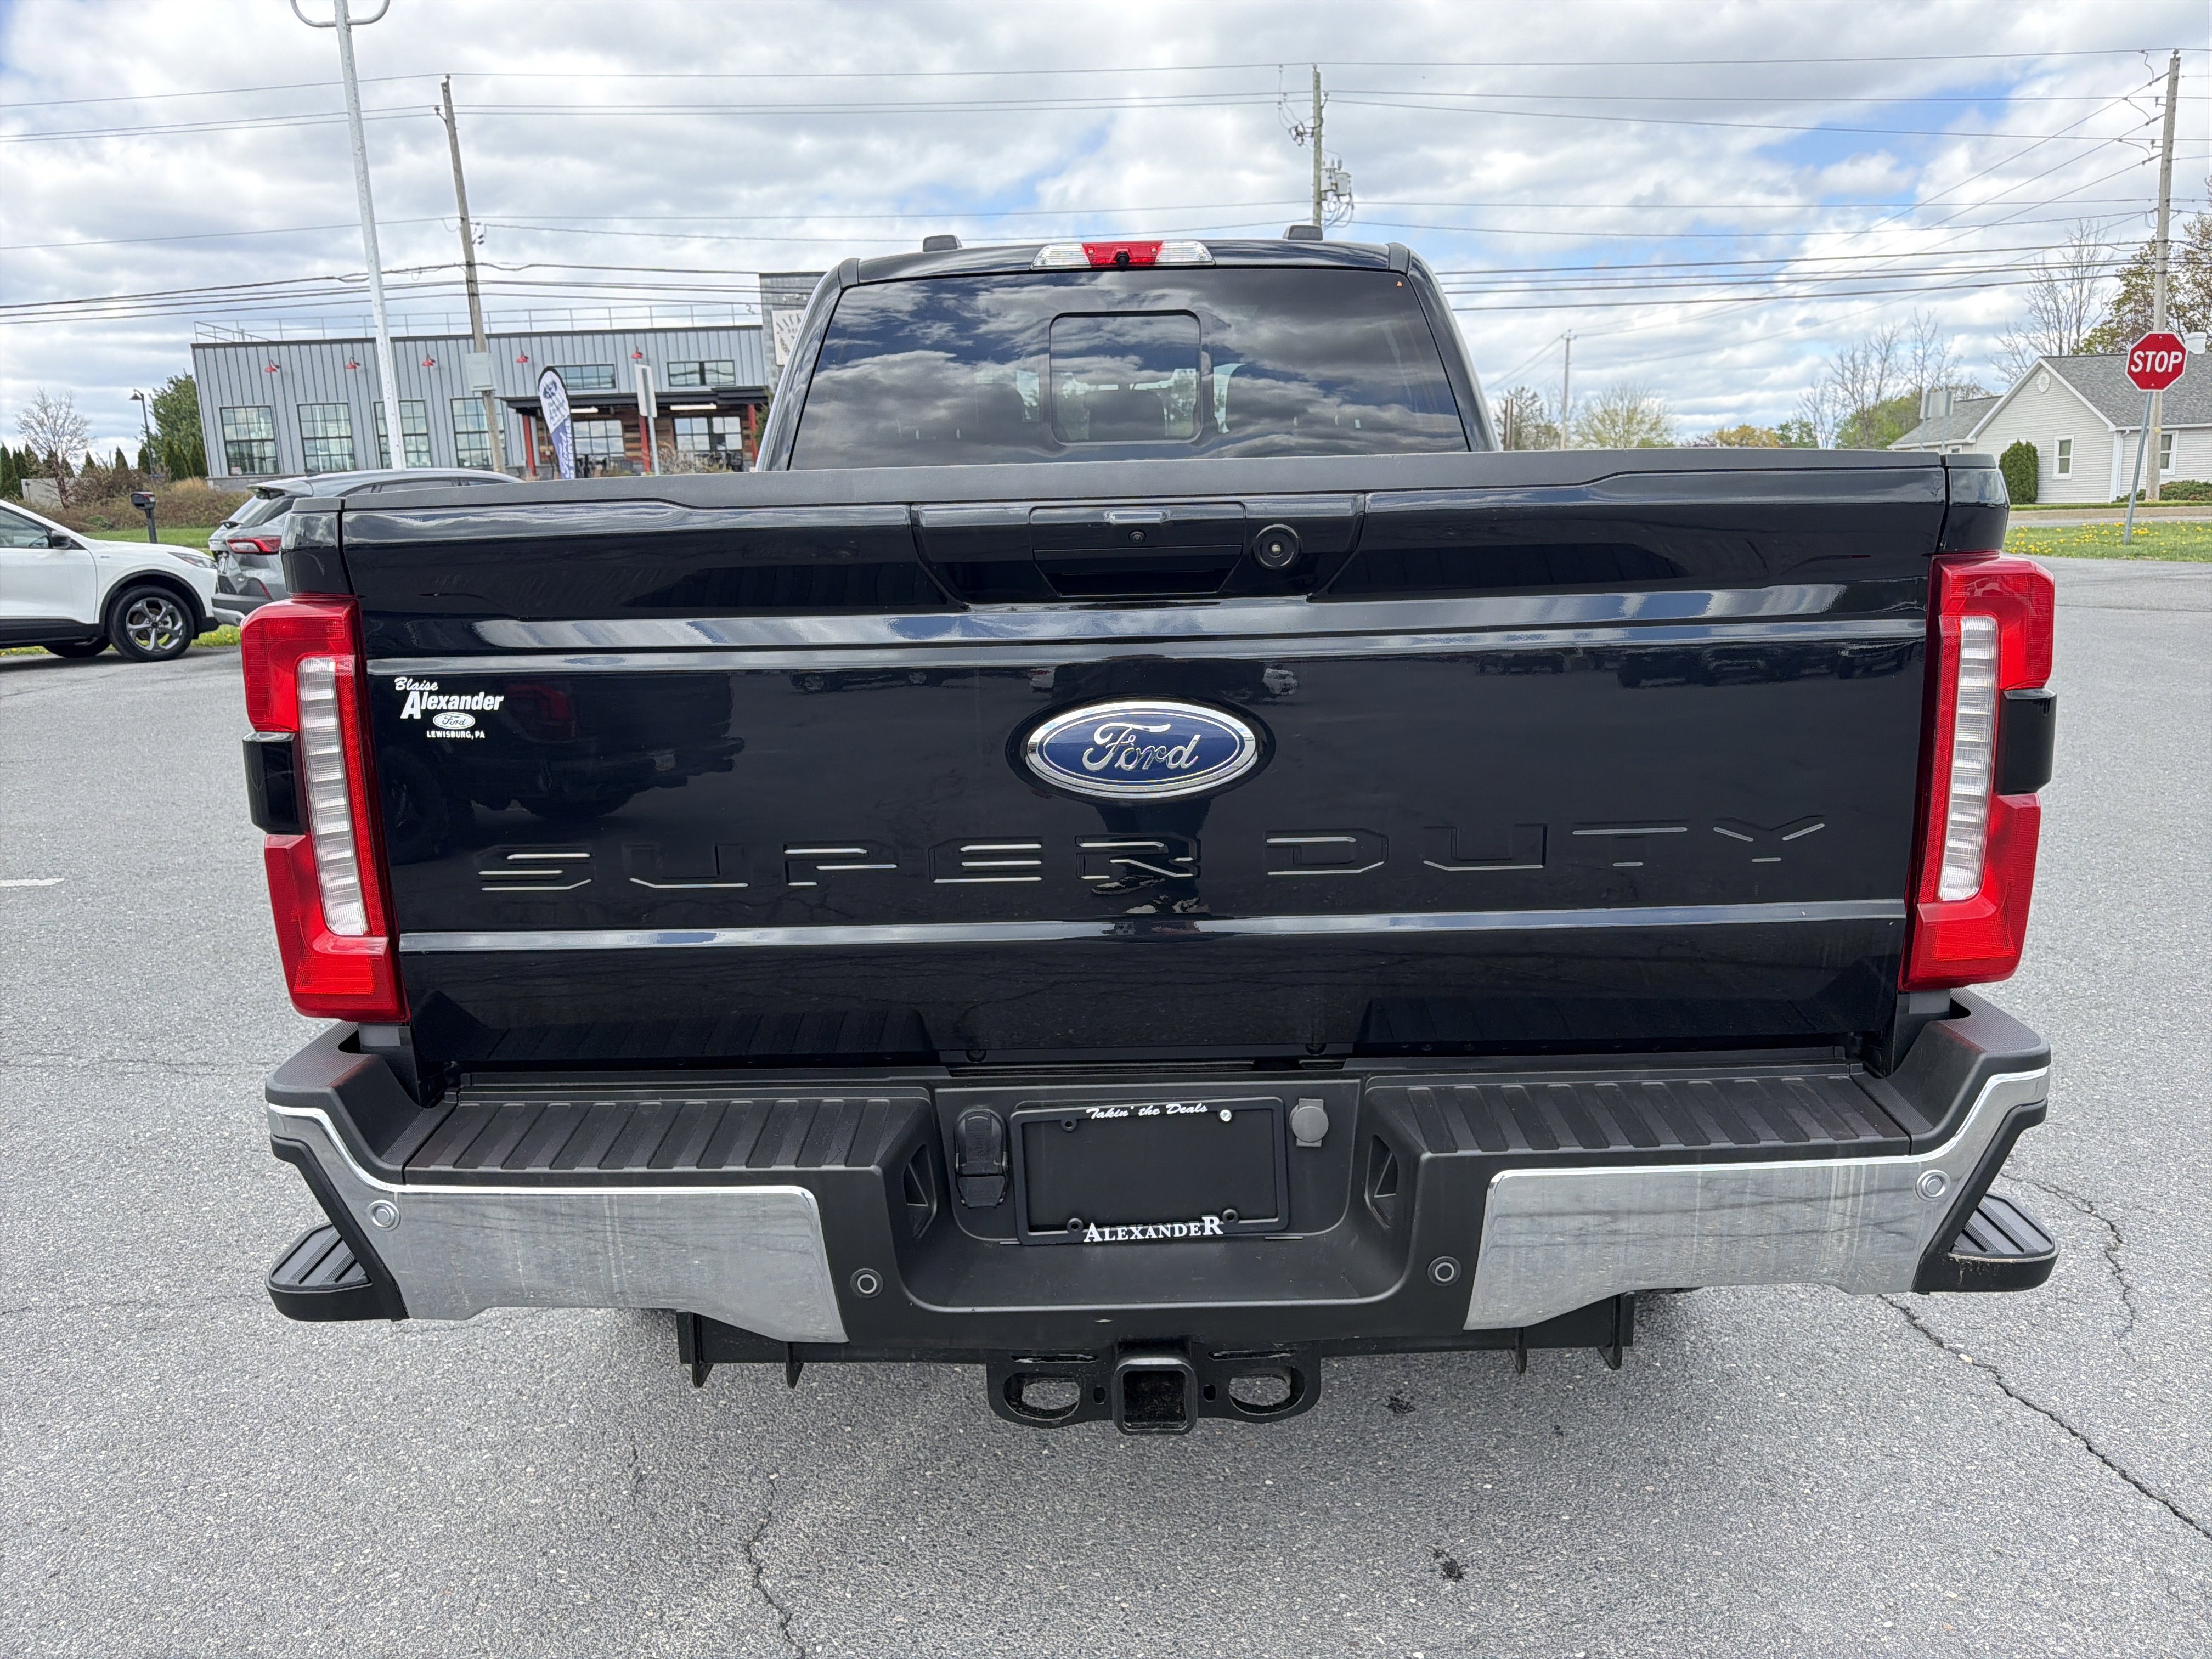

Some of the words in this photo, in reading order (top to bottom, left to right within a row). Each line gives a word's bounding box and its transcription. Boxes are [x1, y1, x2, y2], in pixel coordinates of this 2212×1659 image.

[2130, 350, 2183, 373] STOP
[394, 676, 439, 691] Blaise
[400, 691, 504, 719] Alexander
[442, 715, 467, 726] Ford
[426, 730, 475, 740] LEWISBURG,
[475, 731, 486, 739] PA
[1081, 722, 1201, 771] Ford
[476, 834, 1203, 891] SUPER
[1263, 814, 1826, 877] DUTY
[1086, 1105, 1135, 1119] Takin'
[1138, 1105, 1161, 1116] the
[1165, 1102, 1208, 1114] Deals
[1083, 1216, 1224, 1242] ALEXANDER
